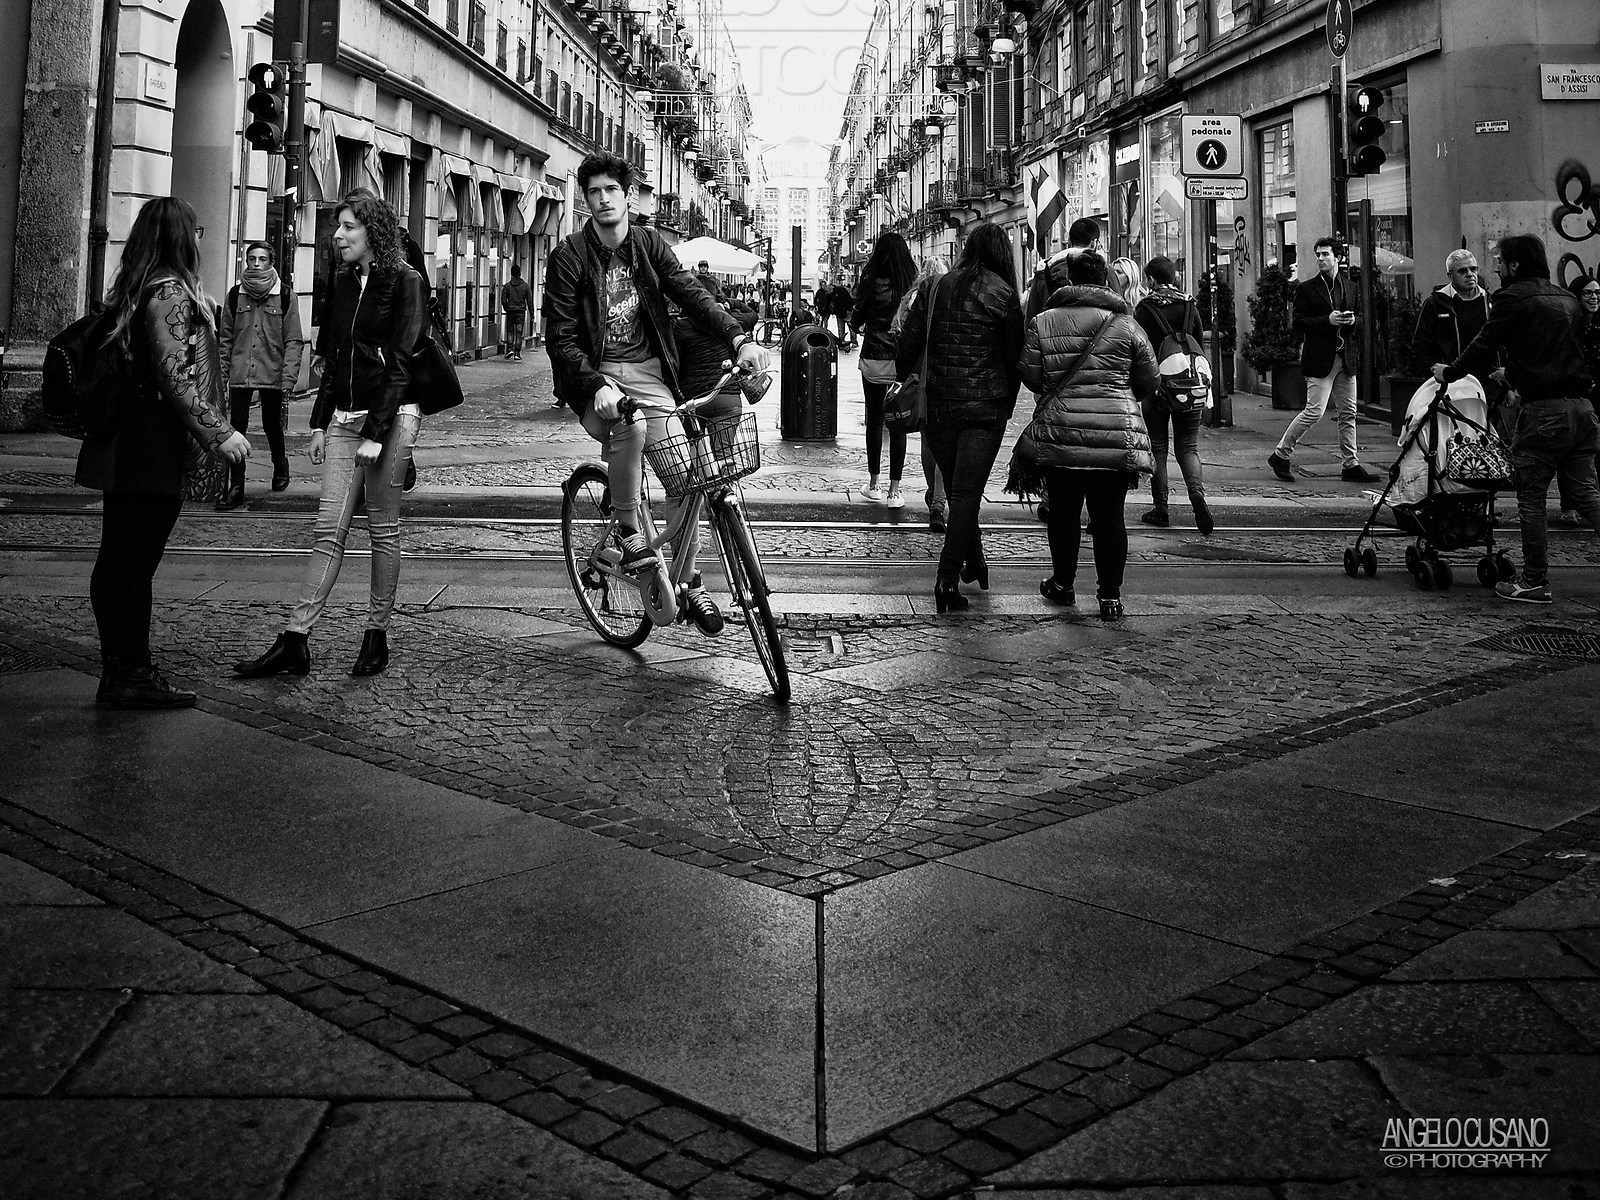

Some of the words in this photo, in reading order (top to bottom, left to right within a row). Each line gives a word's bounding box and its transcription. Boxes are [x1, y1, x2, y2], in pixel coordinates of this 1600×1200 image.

[1546, 75, 1560, 84] SAN
[1562, 75, 1600, 84] FRANCESCO
[1191, 128, 1232, 136] pedonale
